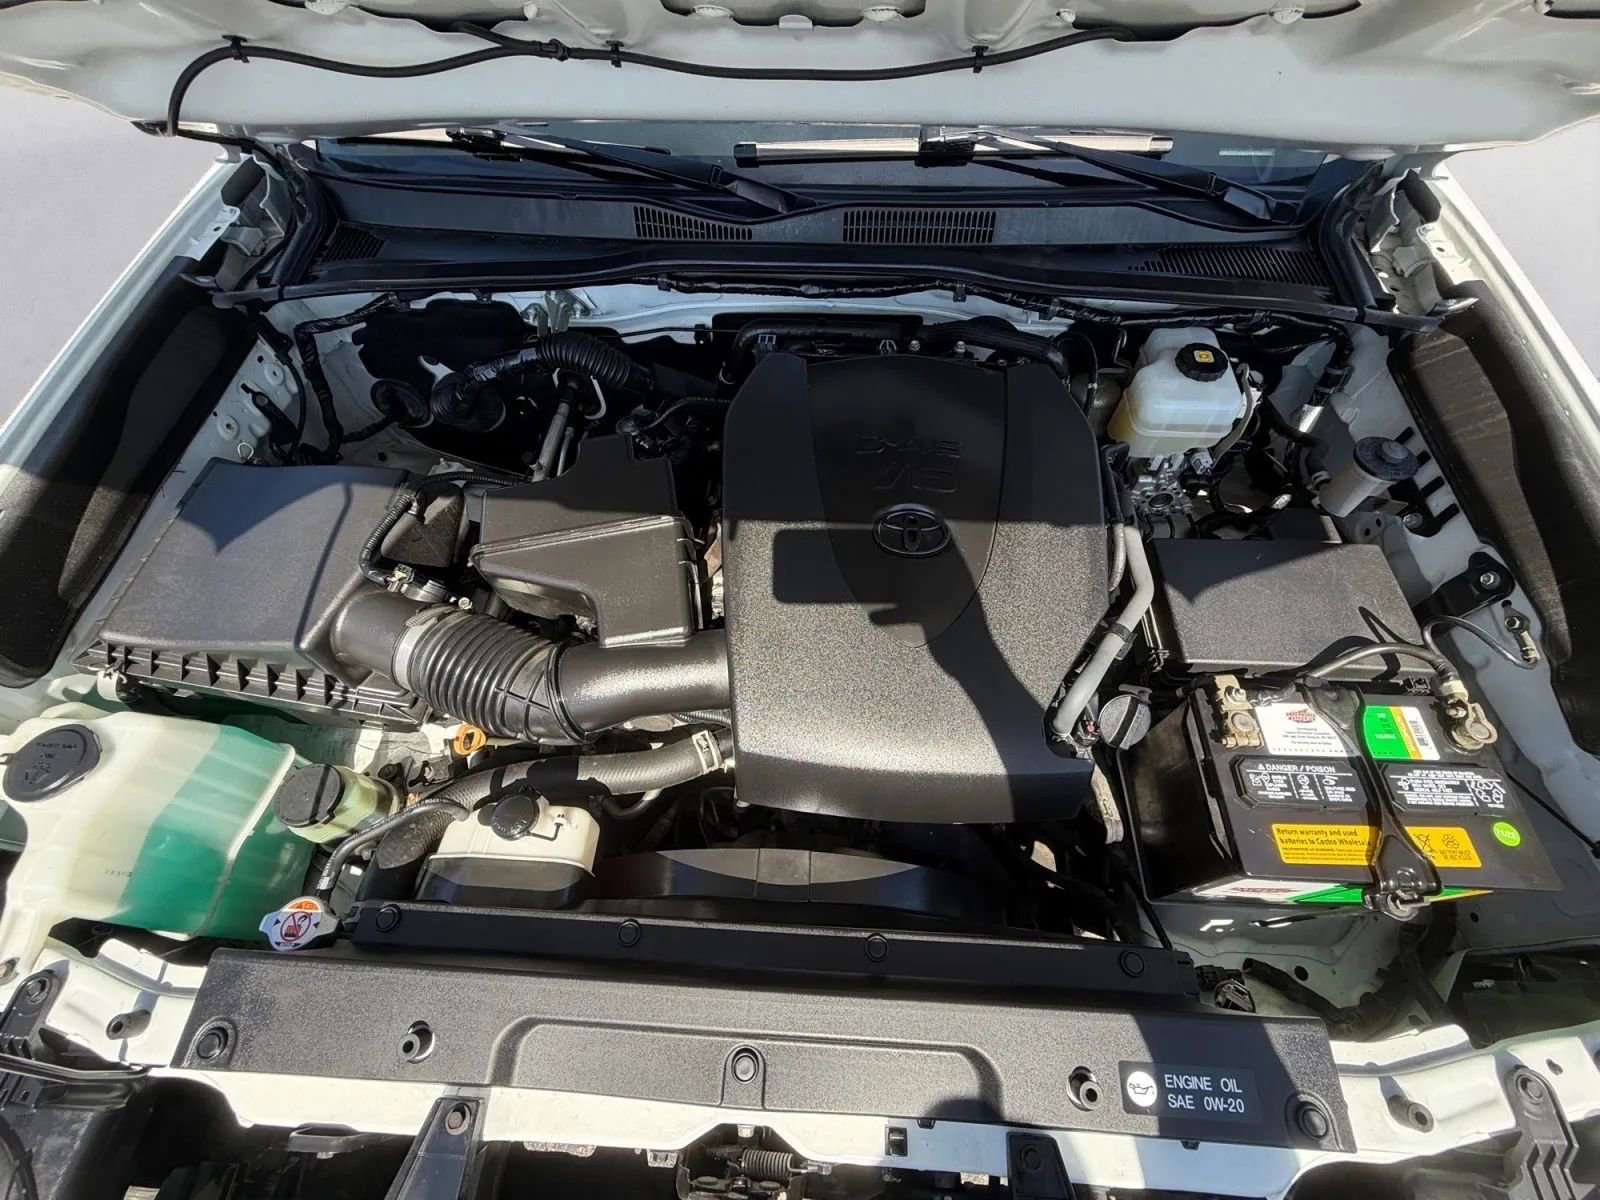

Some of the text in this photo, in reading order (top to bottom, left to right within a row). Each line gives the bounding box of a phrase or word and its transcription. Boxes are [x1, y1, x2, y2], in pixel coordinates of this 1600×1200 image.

[1265, 763, 1299, 772] DANGER
[1305, 765, 1336, 773] POISON
[1277, 828, 1299, 836] Return
[1299, 829, 1328, 837] warranty
[1342, 829, 1358, 837] used
[1280, 837, 1308, 845] batteries
[1164, 1074, 1243, 1093] ENGINE OIL
[1167, 1094, 1245, 1113] SAE 0W-20
